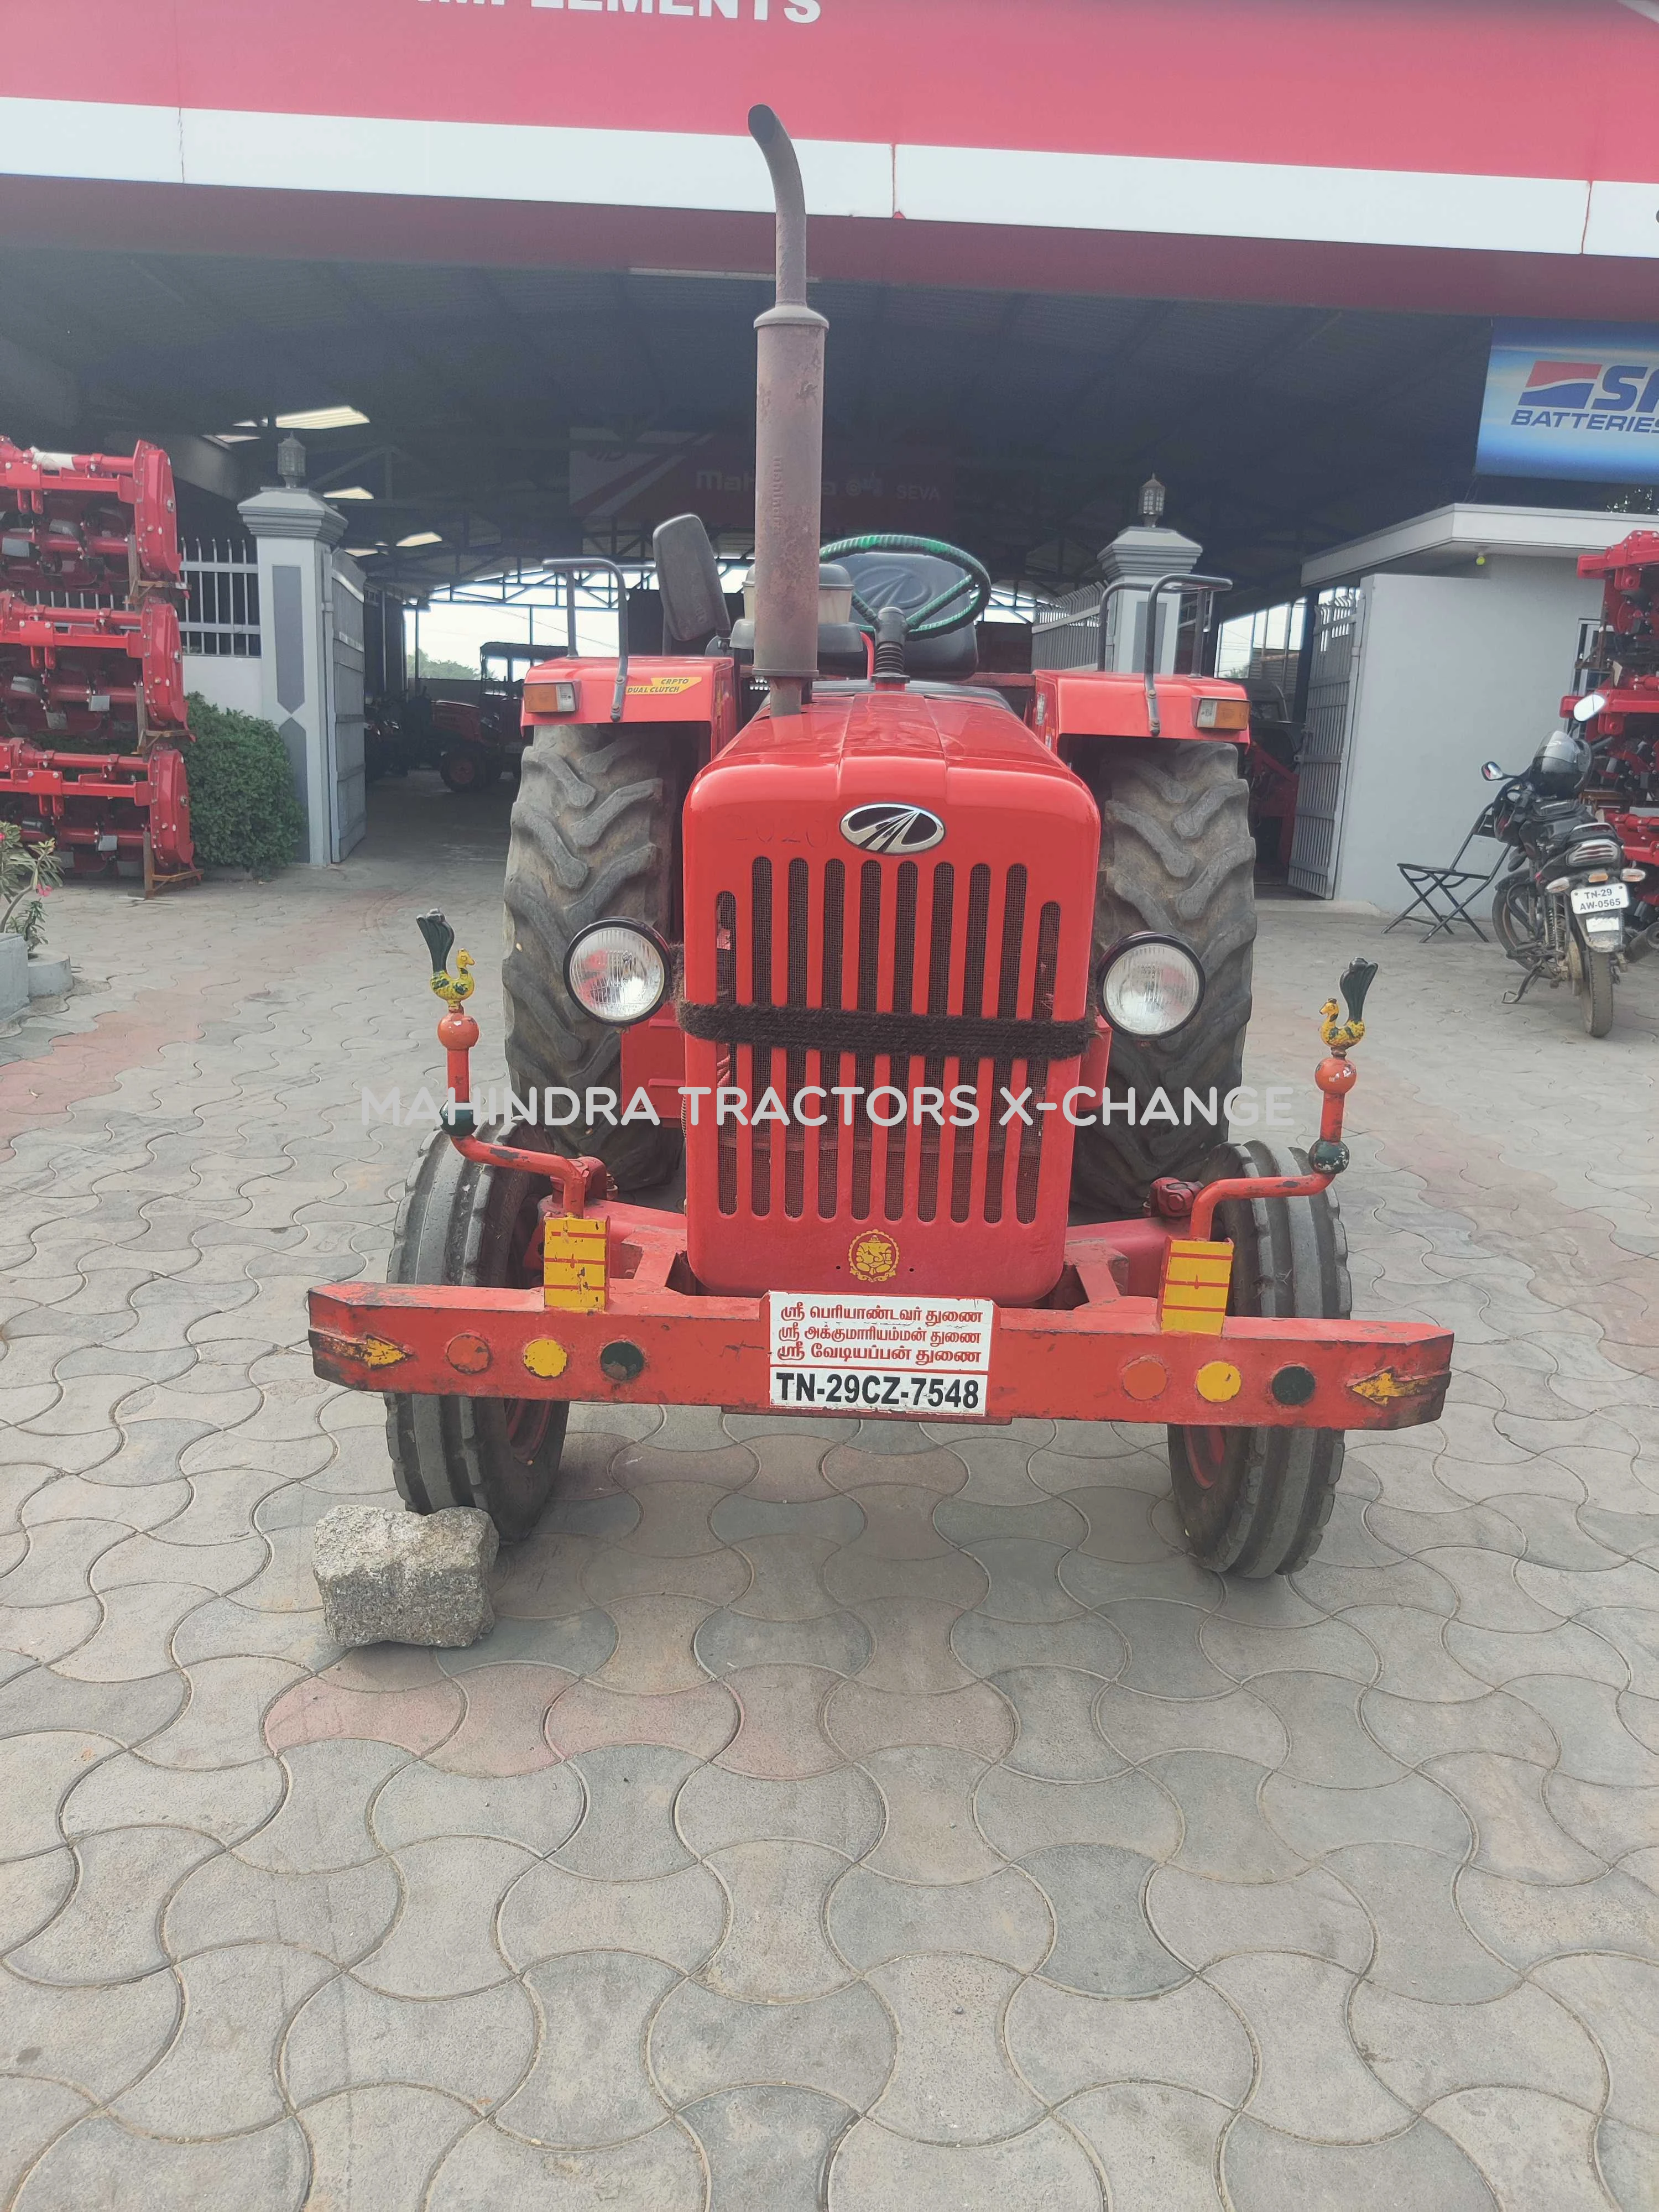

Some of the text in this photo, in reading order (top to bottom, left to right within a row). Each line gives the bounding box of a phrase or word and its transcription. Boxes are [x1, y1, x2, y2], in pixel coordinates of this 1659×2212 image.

[896, 484, 941, 501] SEVA
[1579, 898, 1621, 911] AW-0565
[1583, 888, 1613, 900] TN-29
[810, 1304, 922, 1322] பெரியாண்டவர்
[925, 1309, 983, 1327] துணை
[804, 1324, 927, 1343] அக்குமாரியம்மன்
[930, 1330, 982, 1348] துணை
[811, 1342, 912, 1363] வேடியப்பன்
[915, 1349, 982, 1366] துணை
[776, 1371, 979, 1409] TN-29CZ-7548
